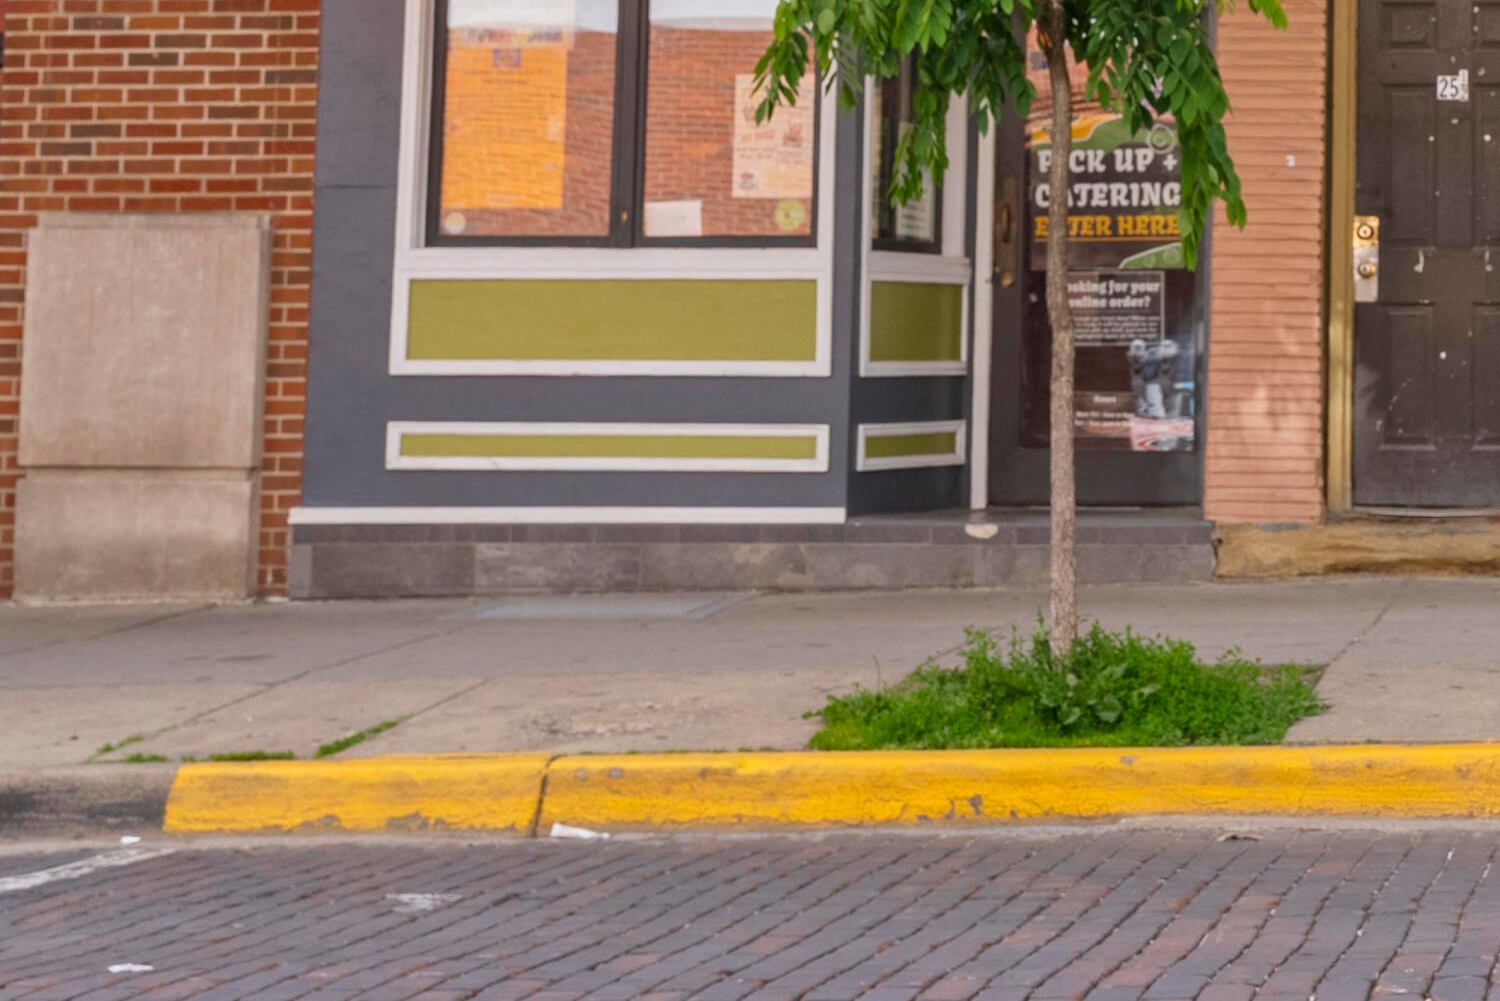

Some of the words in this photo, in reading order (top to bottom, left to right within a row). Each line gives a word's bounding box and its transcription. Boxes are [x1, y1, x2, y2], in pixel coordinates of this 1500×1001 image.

[1439, 78, 1459, 98] 25
[1037, 149, 1106, 173] PCK
[1113, 148, 1155, 172] UP
[1034, 214, 1112, 236] ETER
[1117, 213, 1180, 236] HERE
[1108, 279, 1129, 295] for
[1130, 282, 1160, 295] your
[1109, 295, 1151, 308] order?
